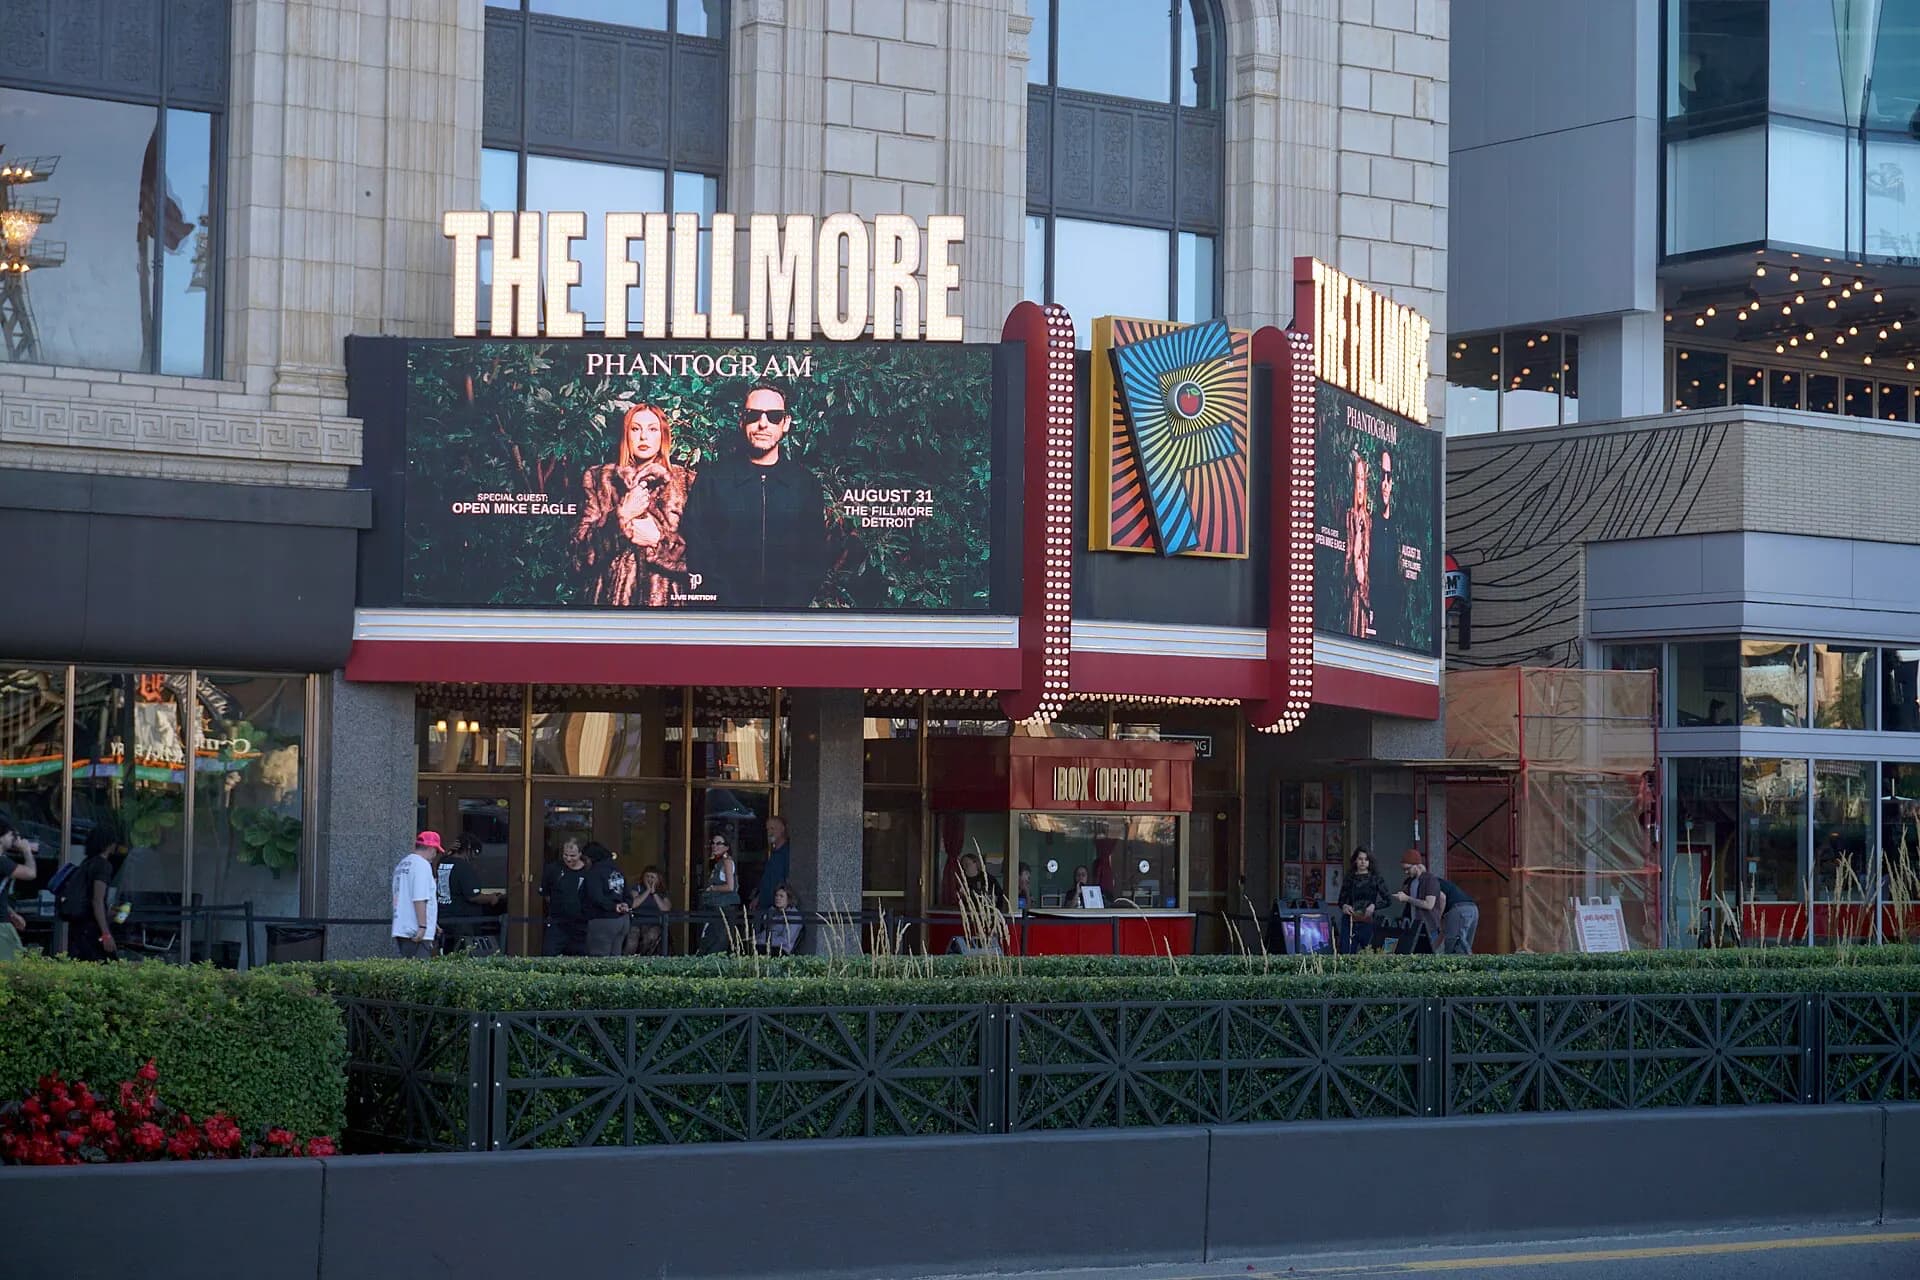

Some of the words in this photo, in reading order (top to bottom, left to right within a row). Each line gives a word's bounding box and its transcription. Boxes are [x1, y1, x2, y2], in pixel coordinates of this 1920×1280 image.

[443, 211, 587, 338] THE
[604, 212, 965, 341] FILLMORE
[1312, 256, 1349, 388] THE
[1350, 278, 1431, 426] FILLMORE
[586, 353, 813, 378] PHANTOGRAM
[1346, 406, 1397, 446] PHANTOGRAM
[477, 493, 514, 502] SPECIAL
[516, 493, 548, 502] GUEST:
[843, 489, 911, 502] AUGUST
[915, 490, 933, 503] 31
[452, 502, 490, 514] OPEN
[494, 503, 527, 514] MIKE
[531, 503, 577, 515] EAGLE
[844, 506, 868, 516] THE
[872, 506, 933, 517] FILLMORE
[861, 517, 915, 528] DETROIT
[1053, 767, 1089, 801] BOX
[1095, 767, 1152, 802] OFFICE
